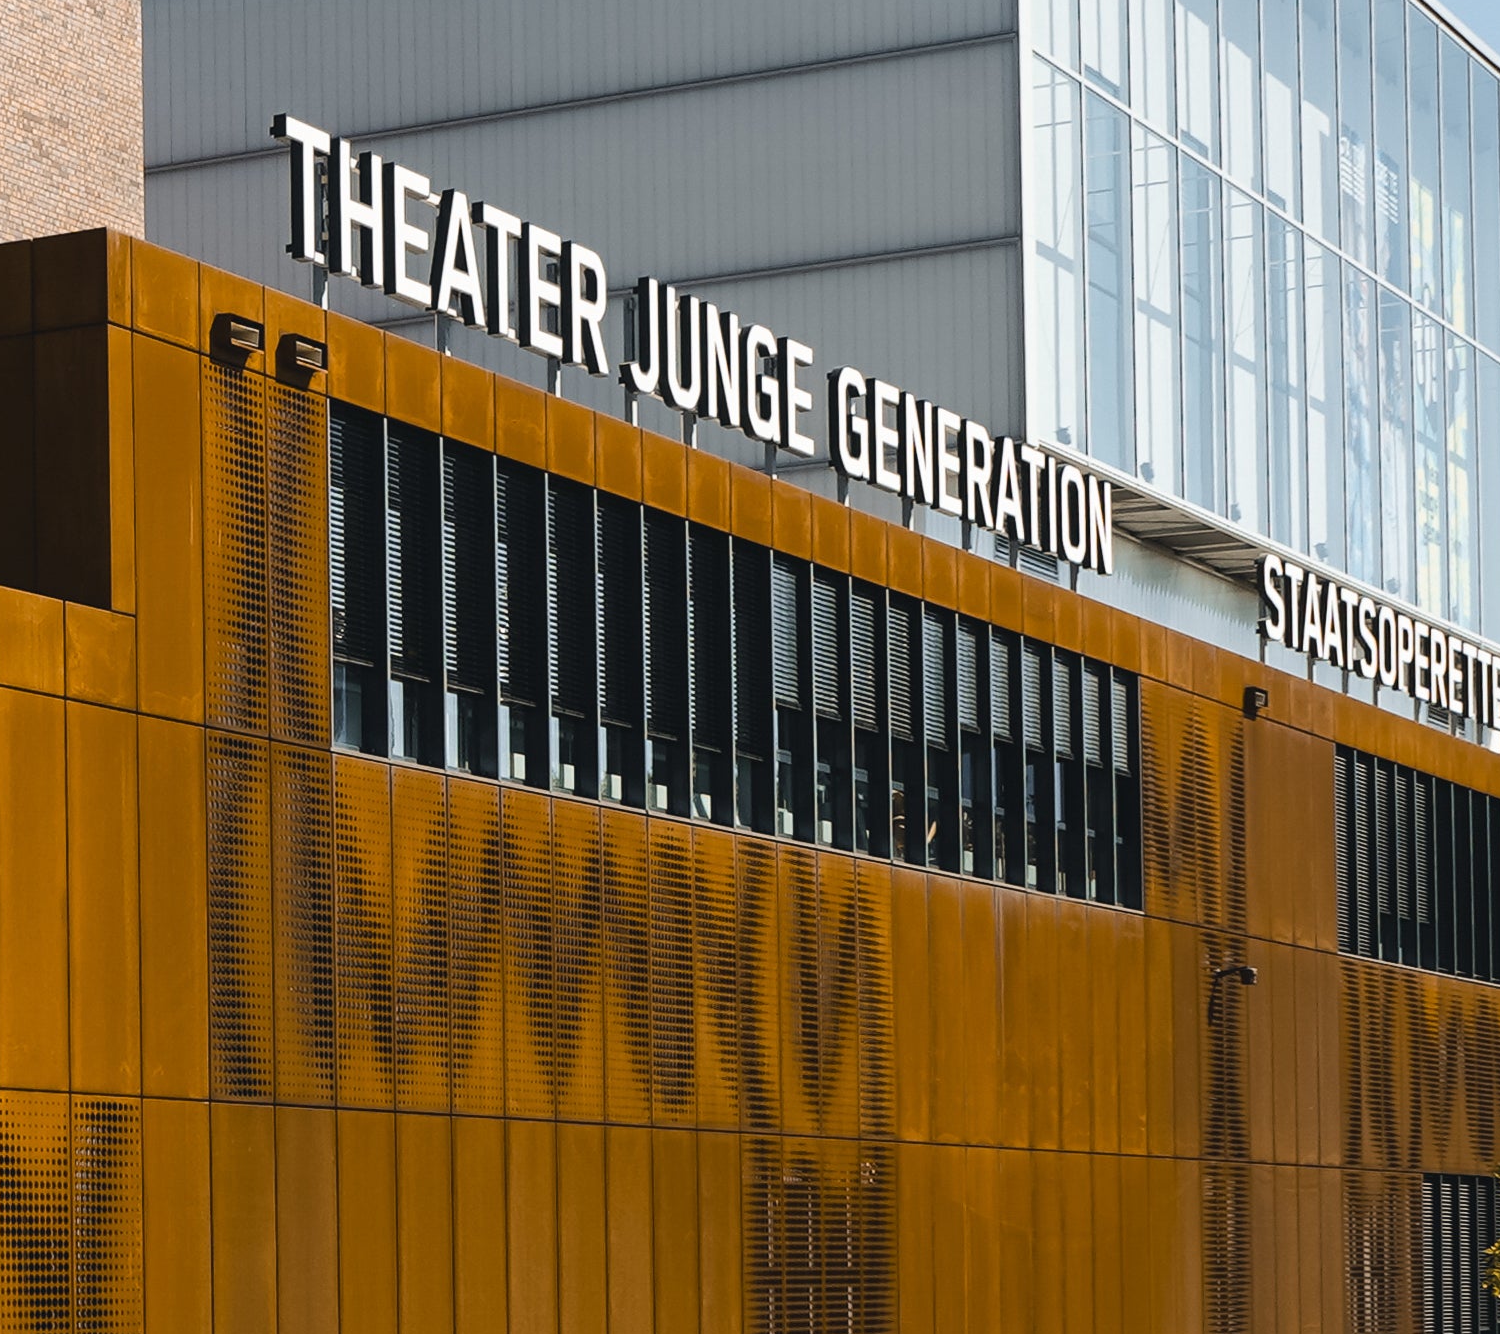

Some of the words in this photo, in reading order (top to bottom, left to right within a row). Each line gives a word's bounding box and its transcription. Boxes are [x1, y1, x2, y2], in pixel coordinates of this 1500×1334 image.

[272, 114, 608, 377] THEATER
[620, 276, 815, 457] JUNGE
[828, 365, 1113, 575] GENERATION
